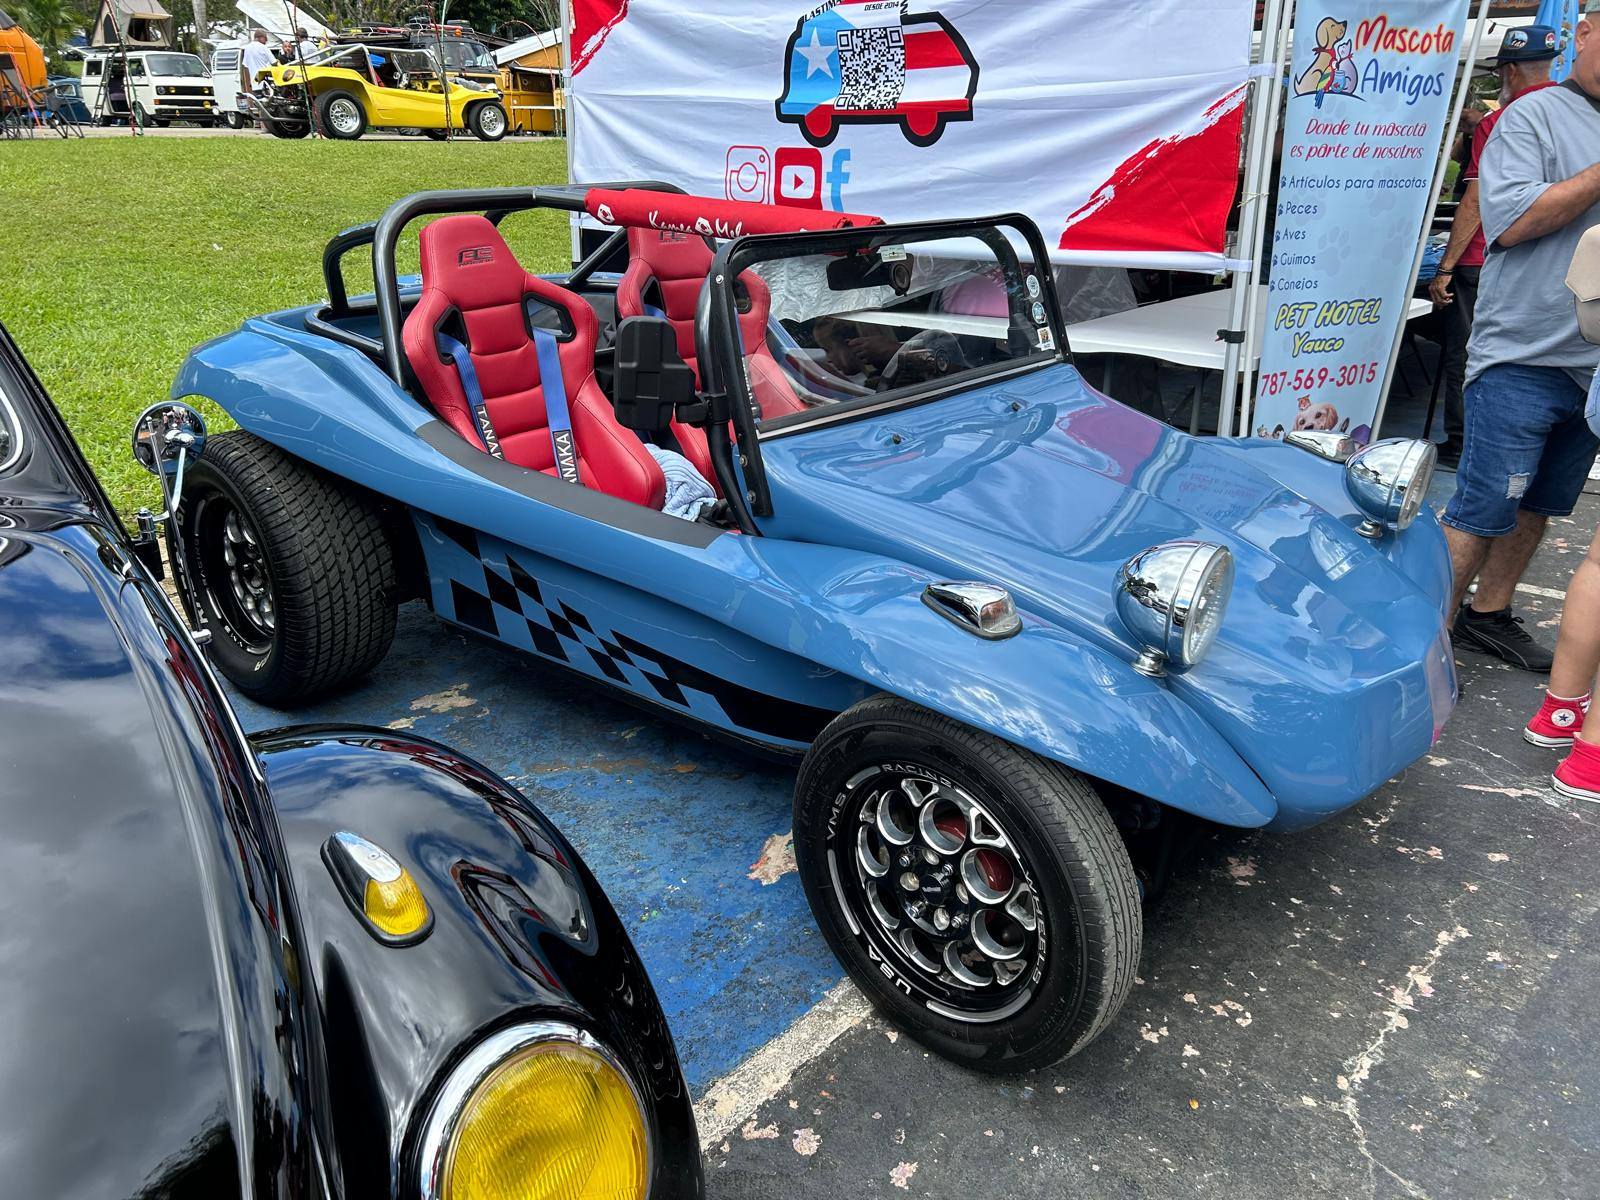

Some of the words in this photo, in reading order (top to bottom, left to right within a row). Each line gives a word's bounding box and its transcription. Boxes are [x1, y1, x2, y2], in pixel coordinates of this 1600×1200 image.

[884, 1, 899, 9] 2014
[1355, 14, 1455, 54] Mascota
[1360, 58, 1445, 105] Amigos
[1305, 118, 1350, 136] Donde
[1354, 121, 1370, 136] tu
[1372, 123, 1429, 137] mascota
[1290, 145, 1303, 159] es
[1305, 143, 1350, 161] parte
[1353, 143, 1370, 159] de
[1372, 145, 1425, 159] nosotros
[1289, 175, 1340, 189] Artículos
[1345, 178, 1374, 190] para
[1378, 176, 1427, 188] mascotas
[1286, 201, 1318, 215] Peces
[1282, 228, 1306, 241] Aves
[1277, 278, 1318, 291] Conejos
[1275, 302, 1318, 331] PET
[1314, 298, 1383, 328] HOTEL
[1292, 331, 1345, 358] Yauco
[1261, 362, 1378, 397] 787-569-3015
[882, 763, 953, 789] RACING
[826, 791, 847, 841] VMS
[1025, 871, 1046, 984] WHEELS
[868, 945, 912, 995] USA
